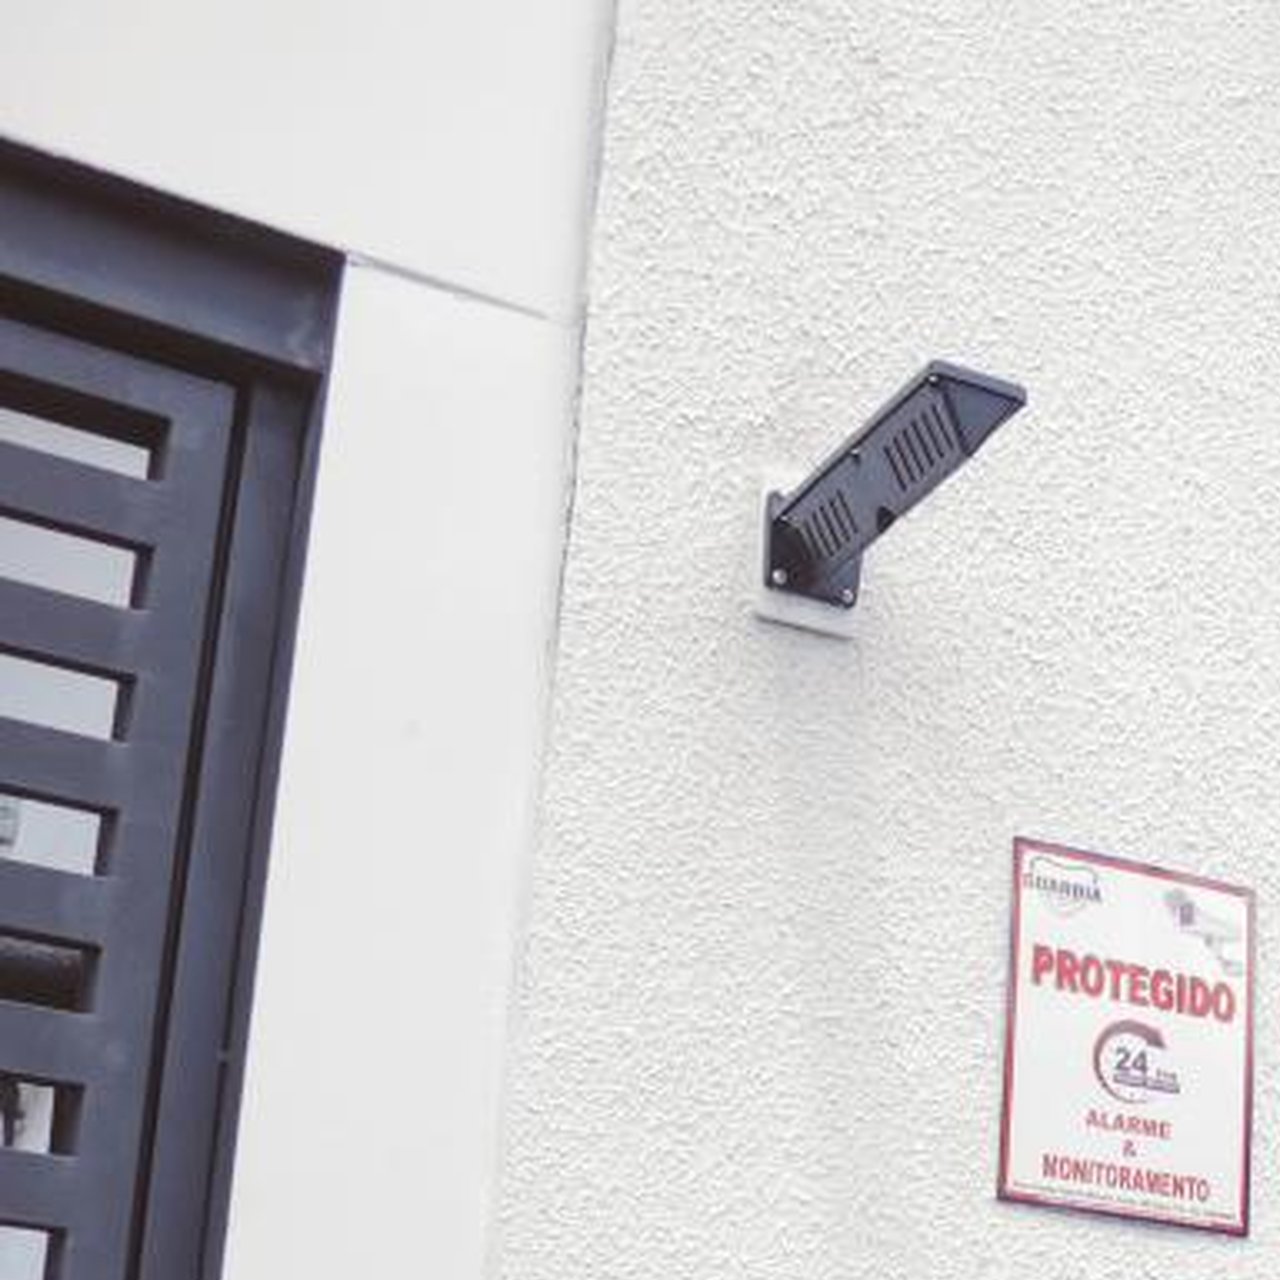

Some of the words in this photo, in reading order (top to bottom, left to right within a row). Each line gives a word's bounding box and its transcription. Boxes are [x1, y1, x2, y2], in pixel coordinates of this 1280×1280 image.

[1032, 943, 1237, 1023] PROTEGIDO
[1113, 1045, 1149, 1075] 24
[1085, 1108, 1174, 1140] ALARME
[1041, 1152, 1211, 1204] MONITORAMENTO
